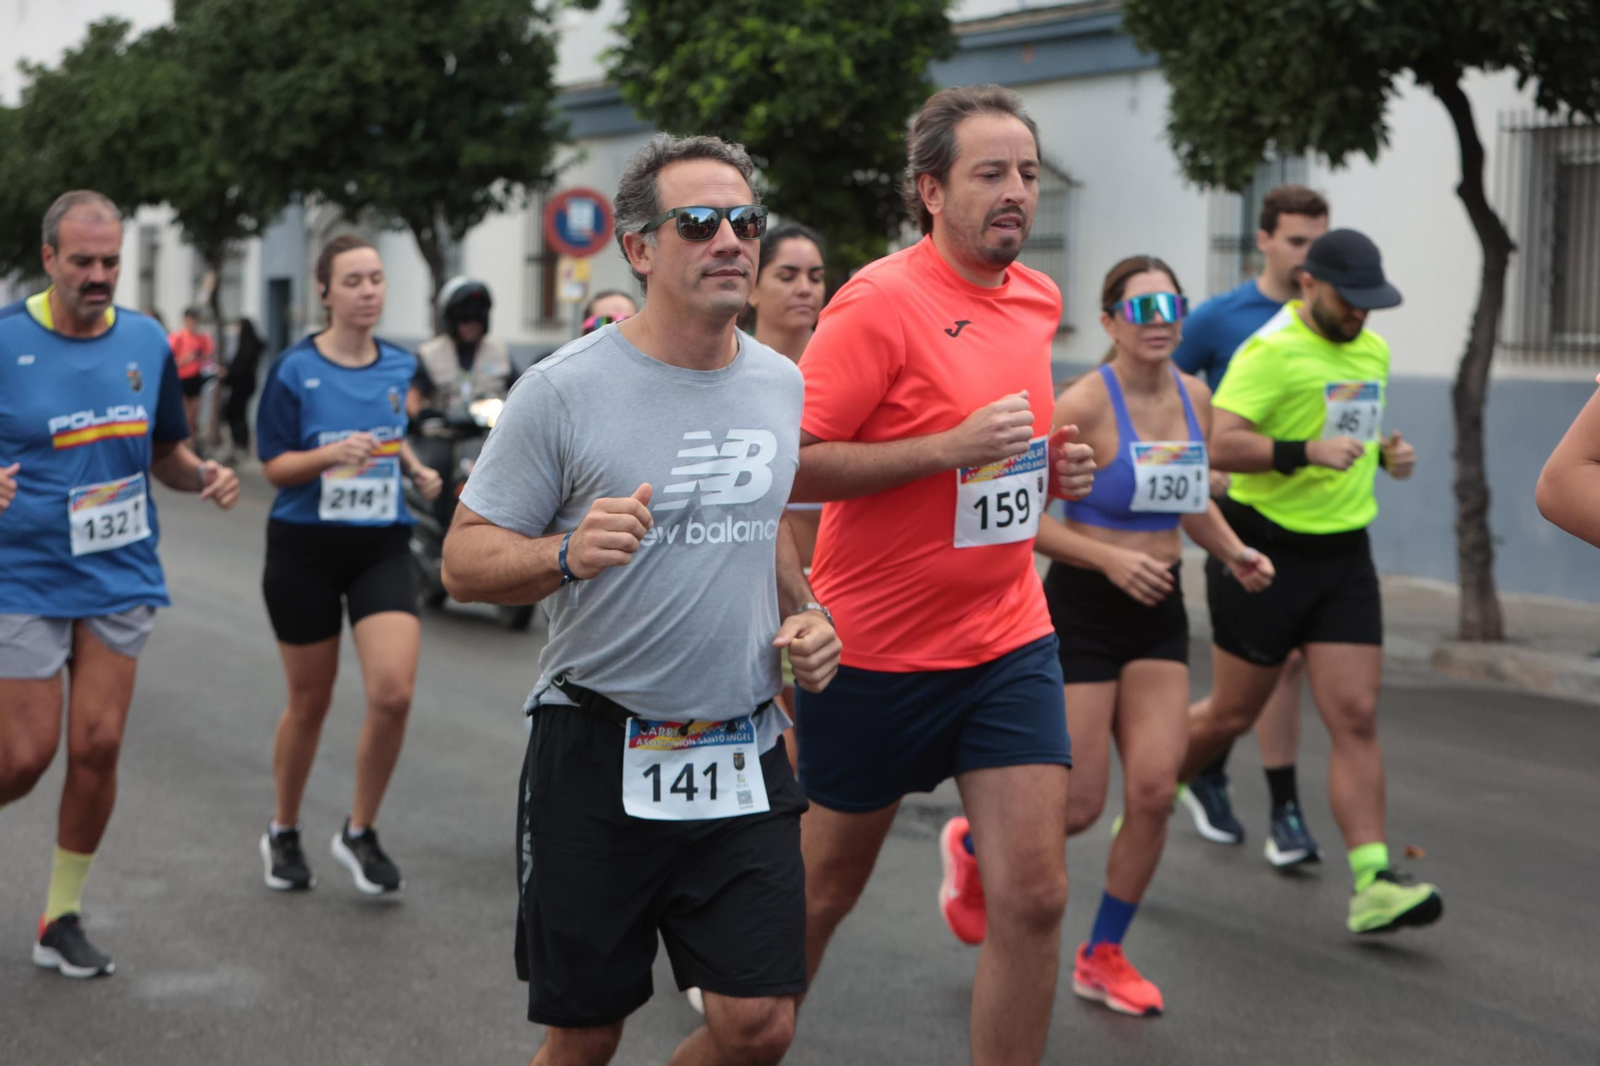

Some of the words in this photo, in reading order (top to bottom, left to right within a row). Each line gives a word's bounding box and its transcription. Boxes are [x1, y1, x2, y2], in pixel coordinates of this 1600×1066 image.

[48, 404, 149, 435] POLICIA
[329, 487, 374, 510] 214
[1147, 474, 1189, 501] 130
[83, 509, 129, 541] 132
[973, 488, 1030, 531] 159
[639, 523, 680, 547] ew
[685, 515, 777, 545] balanc
[697, 733, 725, 745] SANTO
[726, 733, 751, 742] ANGEL
[642, 762, 718, 802] 141
